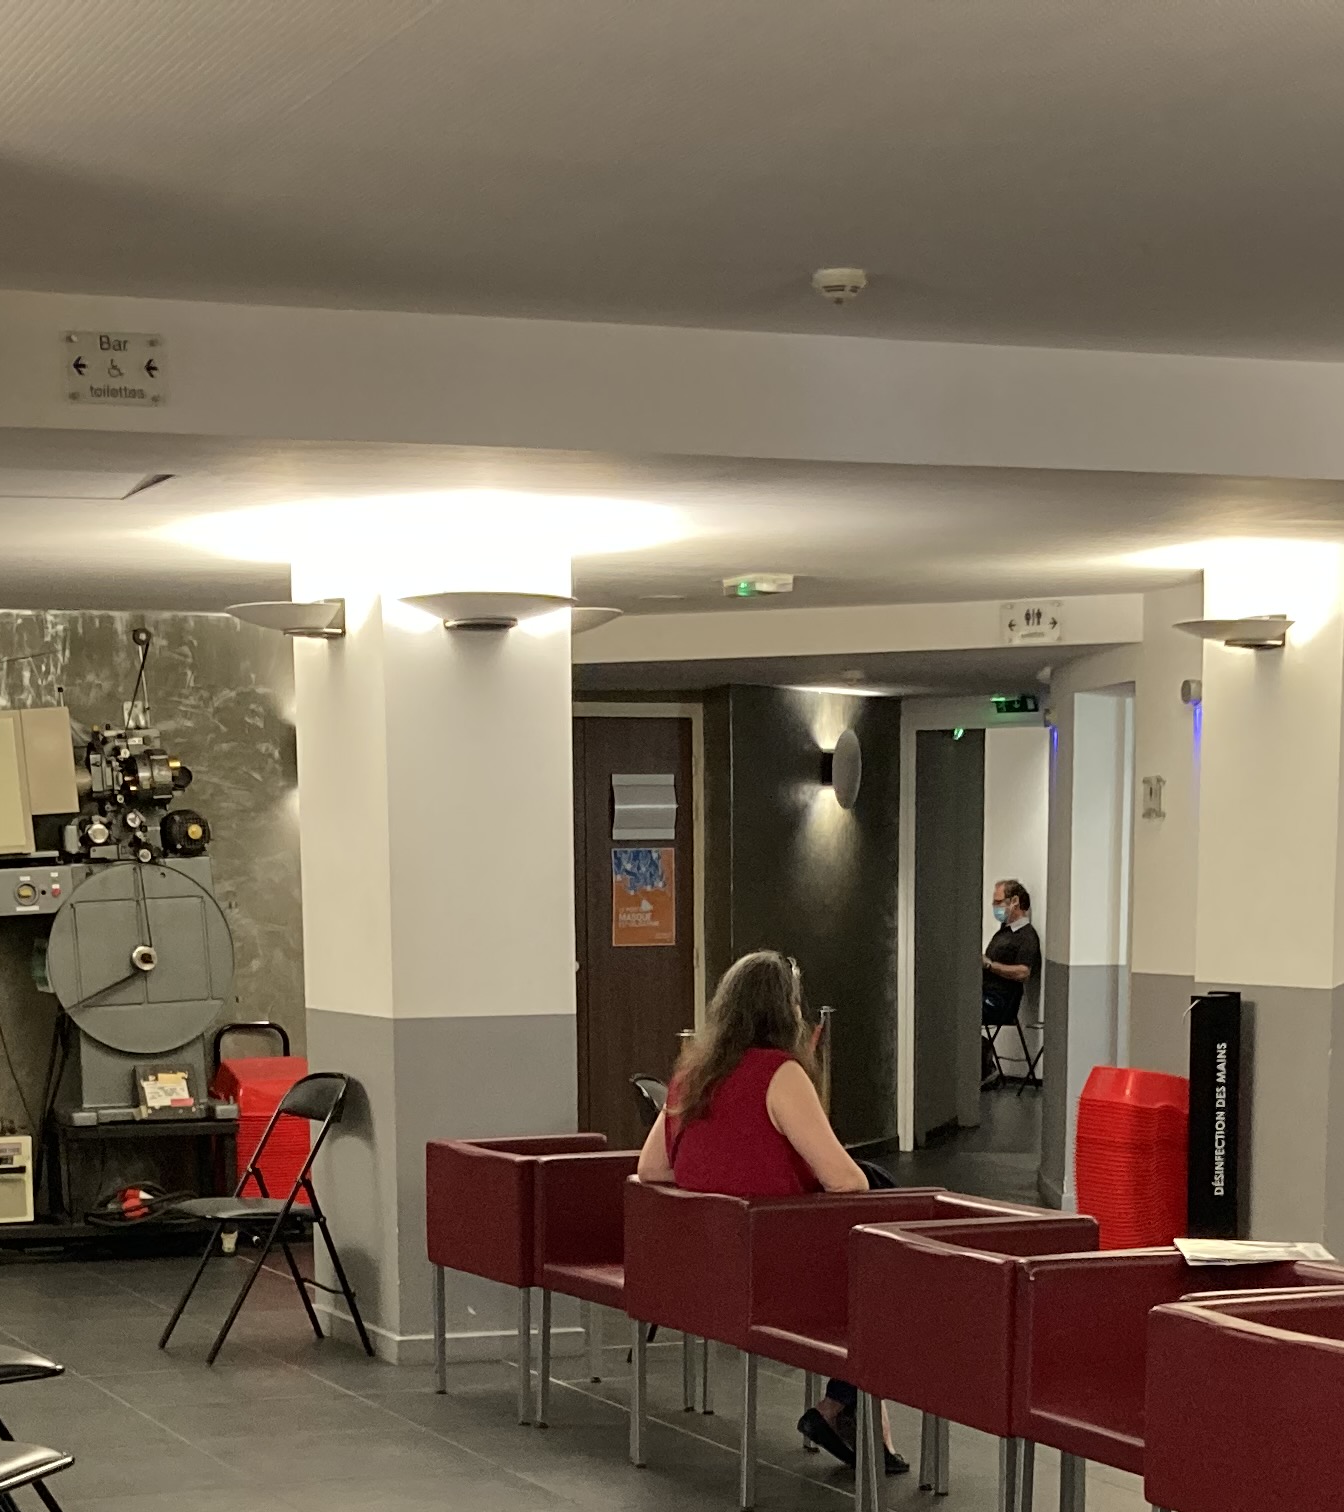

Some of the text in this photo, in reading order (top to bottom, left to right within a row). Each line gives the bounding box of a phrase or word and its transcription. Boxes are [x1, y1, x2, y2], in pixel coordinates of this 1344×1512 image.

[99, 335, 129, 352] Bar
[89, 385, 146, 400] toilettes
[1211, 1042, 1228, 1197] DÉSINFECTION DES MAINS
